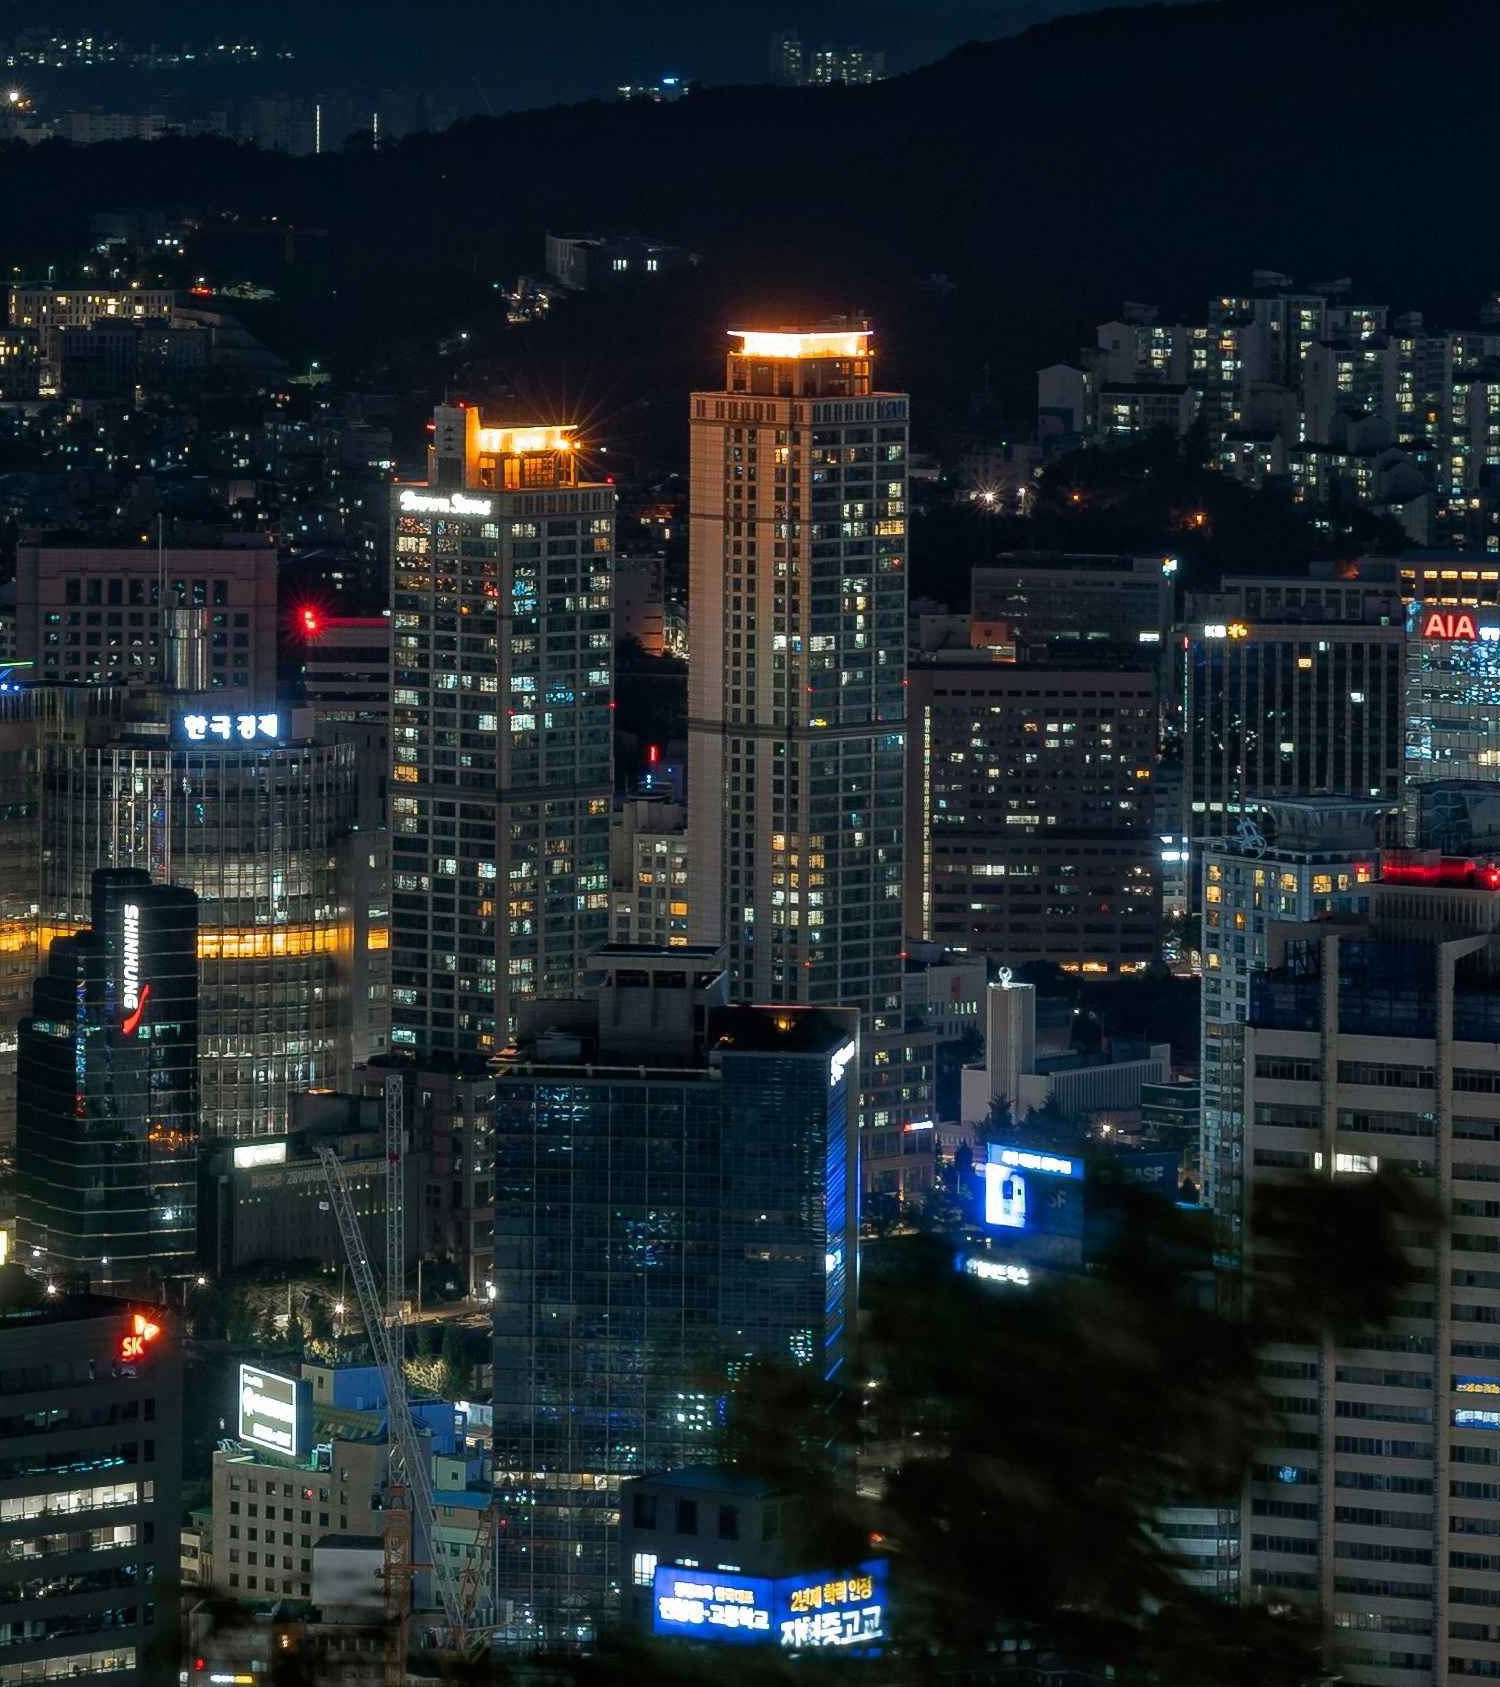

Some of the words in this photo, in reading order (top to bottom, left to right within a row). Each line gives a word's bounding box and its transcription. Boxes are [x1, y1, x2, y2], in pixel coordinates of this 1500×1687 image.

[1424, 613, 1477, 639] AIA
[184, 714, 278, 739] 한국경제
[123, 904, 139, 1009] SHINHUNG
[122, 1337, 143, 1356] SK
[791, 1586, 822, 1612] 2년제
[823, 1580, 847, 1605] 학력
[848, 1576, 872, 1601] 인정
